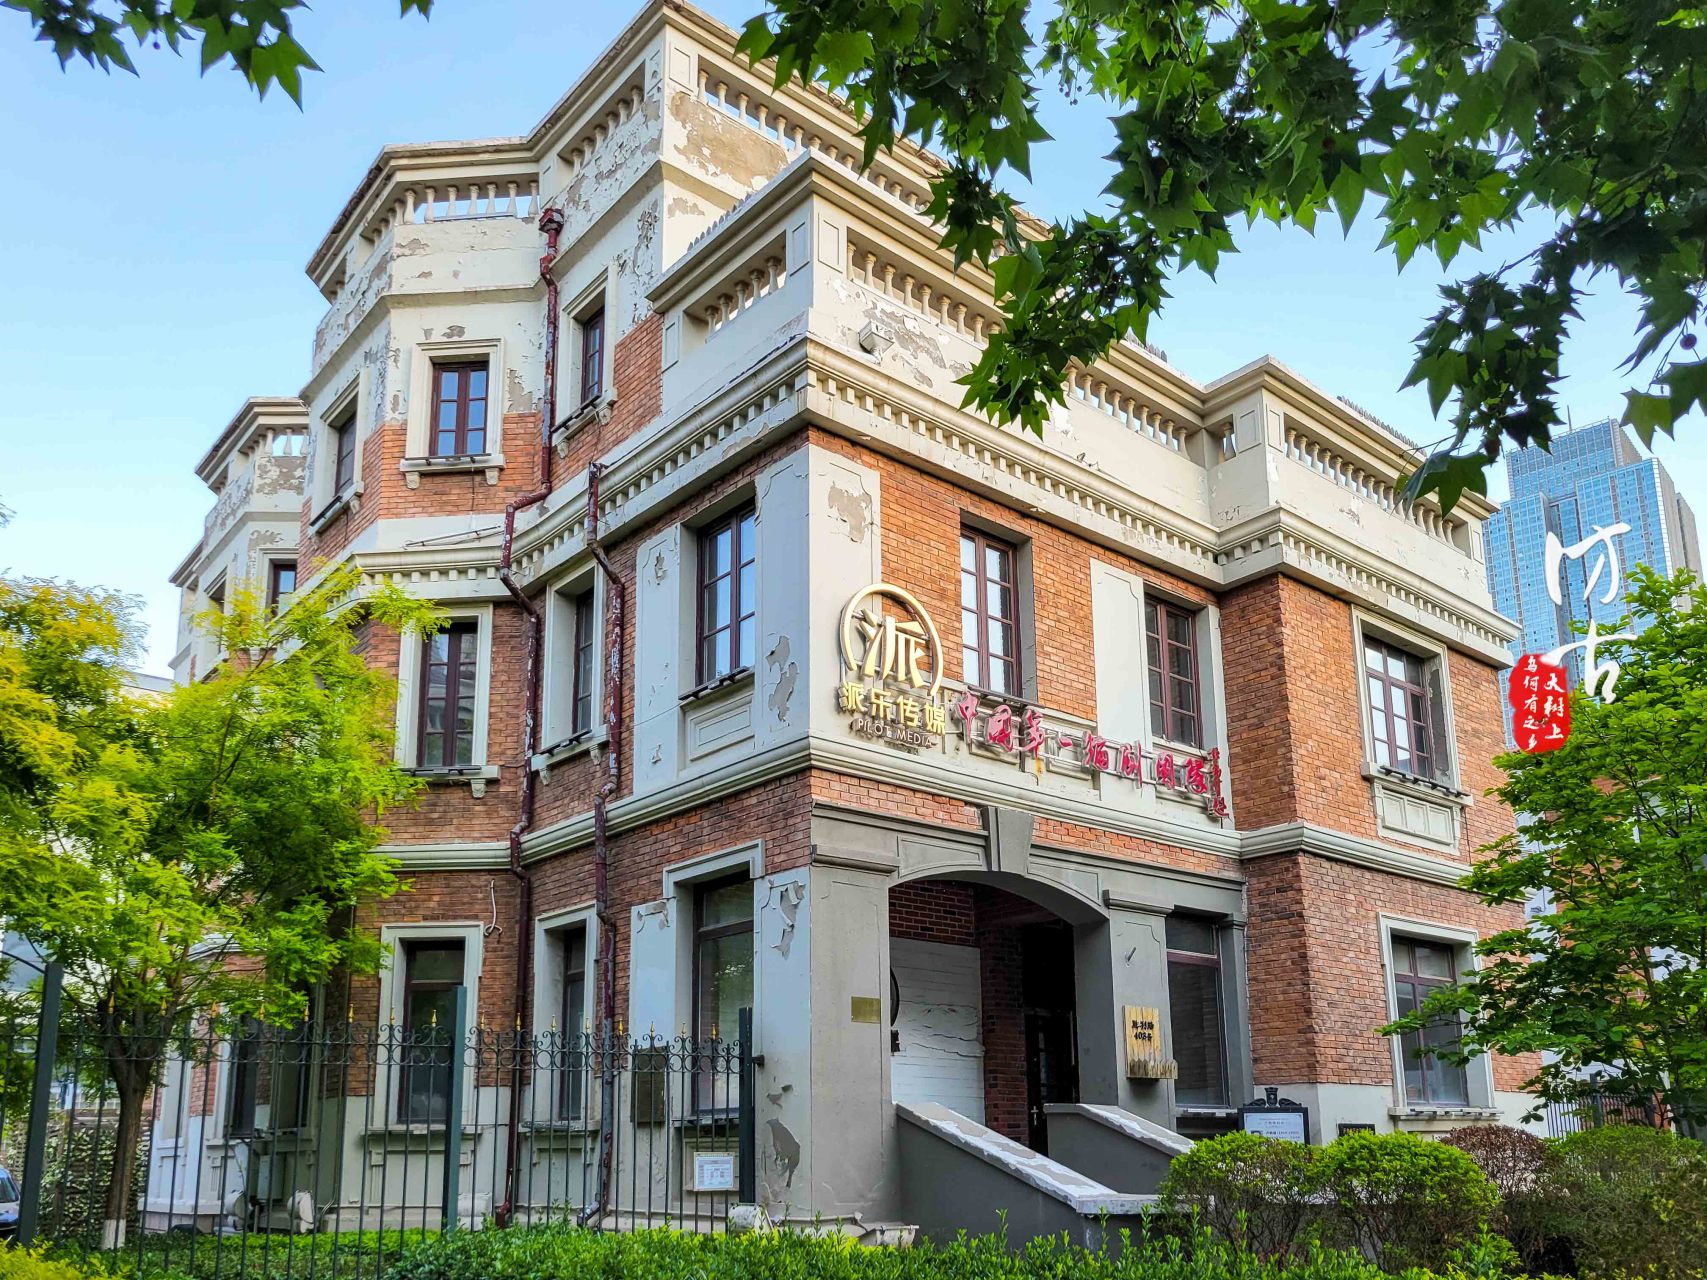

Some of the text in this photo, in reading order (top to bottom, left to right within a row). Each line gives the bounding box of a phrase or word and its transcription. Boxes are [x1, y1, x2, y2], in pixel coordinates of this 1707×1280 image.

[838, 681, 946, 736] 派乐传媒
[857, 716, 934, 748] PILOT MEDIA
